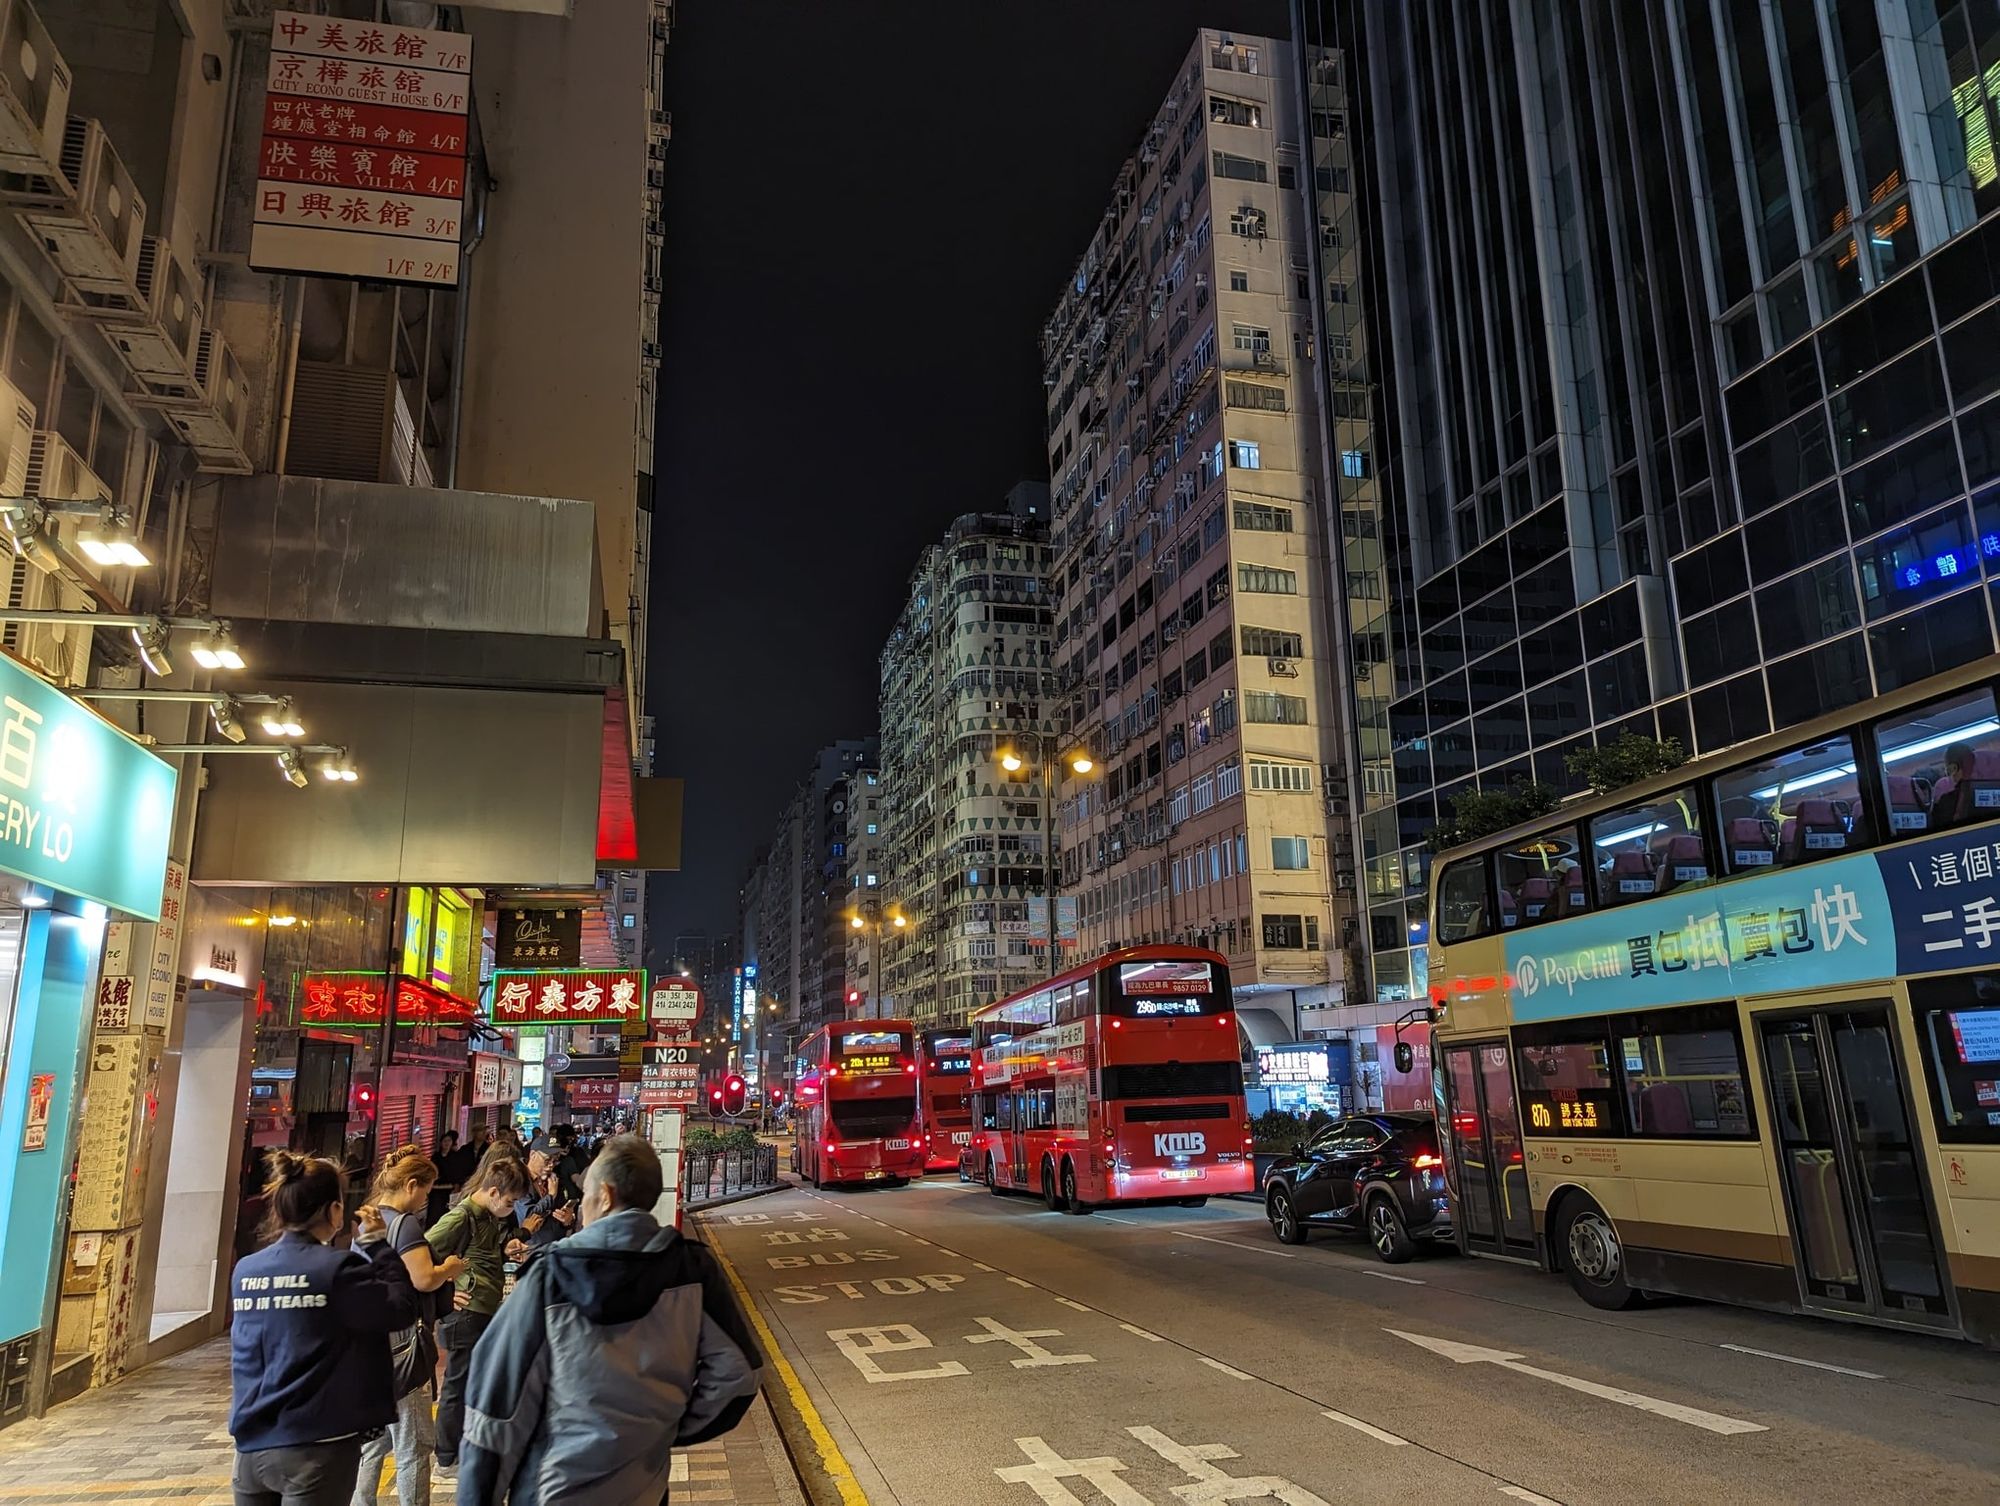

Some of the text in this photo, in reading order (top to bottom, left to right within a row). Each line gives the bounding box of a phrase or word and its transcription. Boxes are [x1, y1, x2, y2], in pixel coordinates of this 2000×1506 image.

[280, 18, 428, 59] 中美旅館
[437, 51, 467, 70] 7/F
[273, 79, 429, 107] CITY ECONO GUEST HOUSE
[433, 92, 463, 110] 6/F
[273, 101, 356, 121] 四代老牌
[430, 135, 460, 150] 4/F
[268, 140, 420, 178] 快樂賓館
[299, 169, 340, 183] LOK
[355, 174, 416, 191] VILLA
[427, 177, 458, 194] 4/F
[263, 190, 415, 228] 日興旅館
[425, 217, 456, 236] 3/F
[386, 258, 452, 280] 1/F 2/F
[42, 816, 73, 862] LO
[1627, 884, 1868, 979] 買包抵賣包快
[1922, 896, 2000, 955] 二手
[1543, 945, 1622, 997] PopChill
[1136, 1000, 1157, 1014] 296D
[655, 1048, 688, 1064] N20
[643, 1067, 658, 1077] 41A
[580, 1084, 614, 1094] 周大福
[1532, 1104, 1550, 1127] 87D
[885, 1138, 909, 1151] KMB
[952, 1131, 972, 1144] KM
[1154, 1132, 1206, 1157] KMB
[728, 1211, 827, 1226] 巴士
[761, 1228, 850, 1246] 站
[766, 1250, 900, 1270] BUS
[240, 1274, 309, 1291] THIS WILL
[773, 1273, 966, 1304] STOP
[256, 1296, 270, 1311] IN
[273, 1294, 327, 1309] TEARS
[825, 1317, 1098, 1384] 巴士
